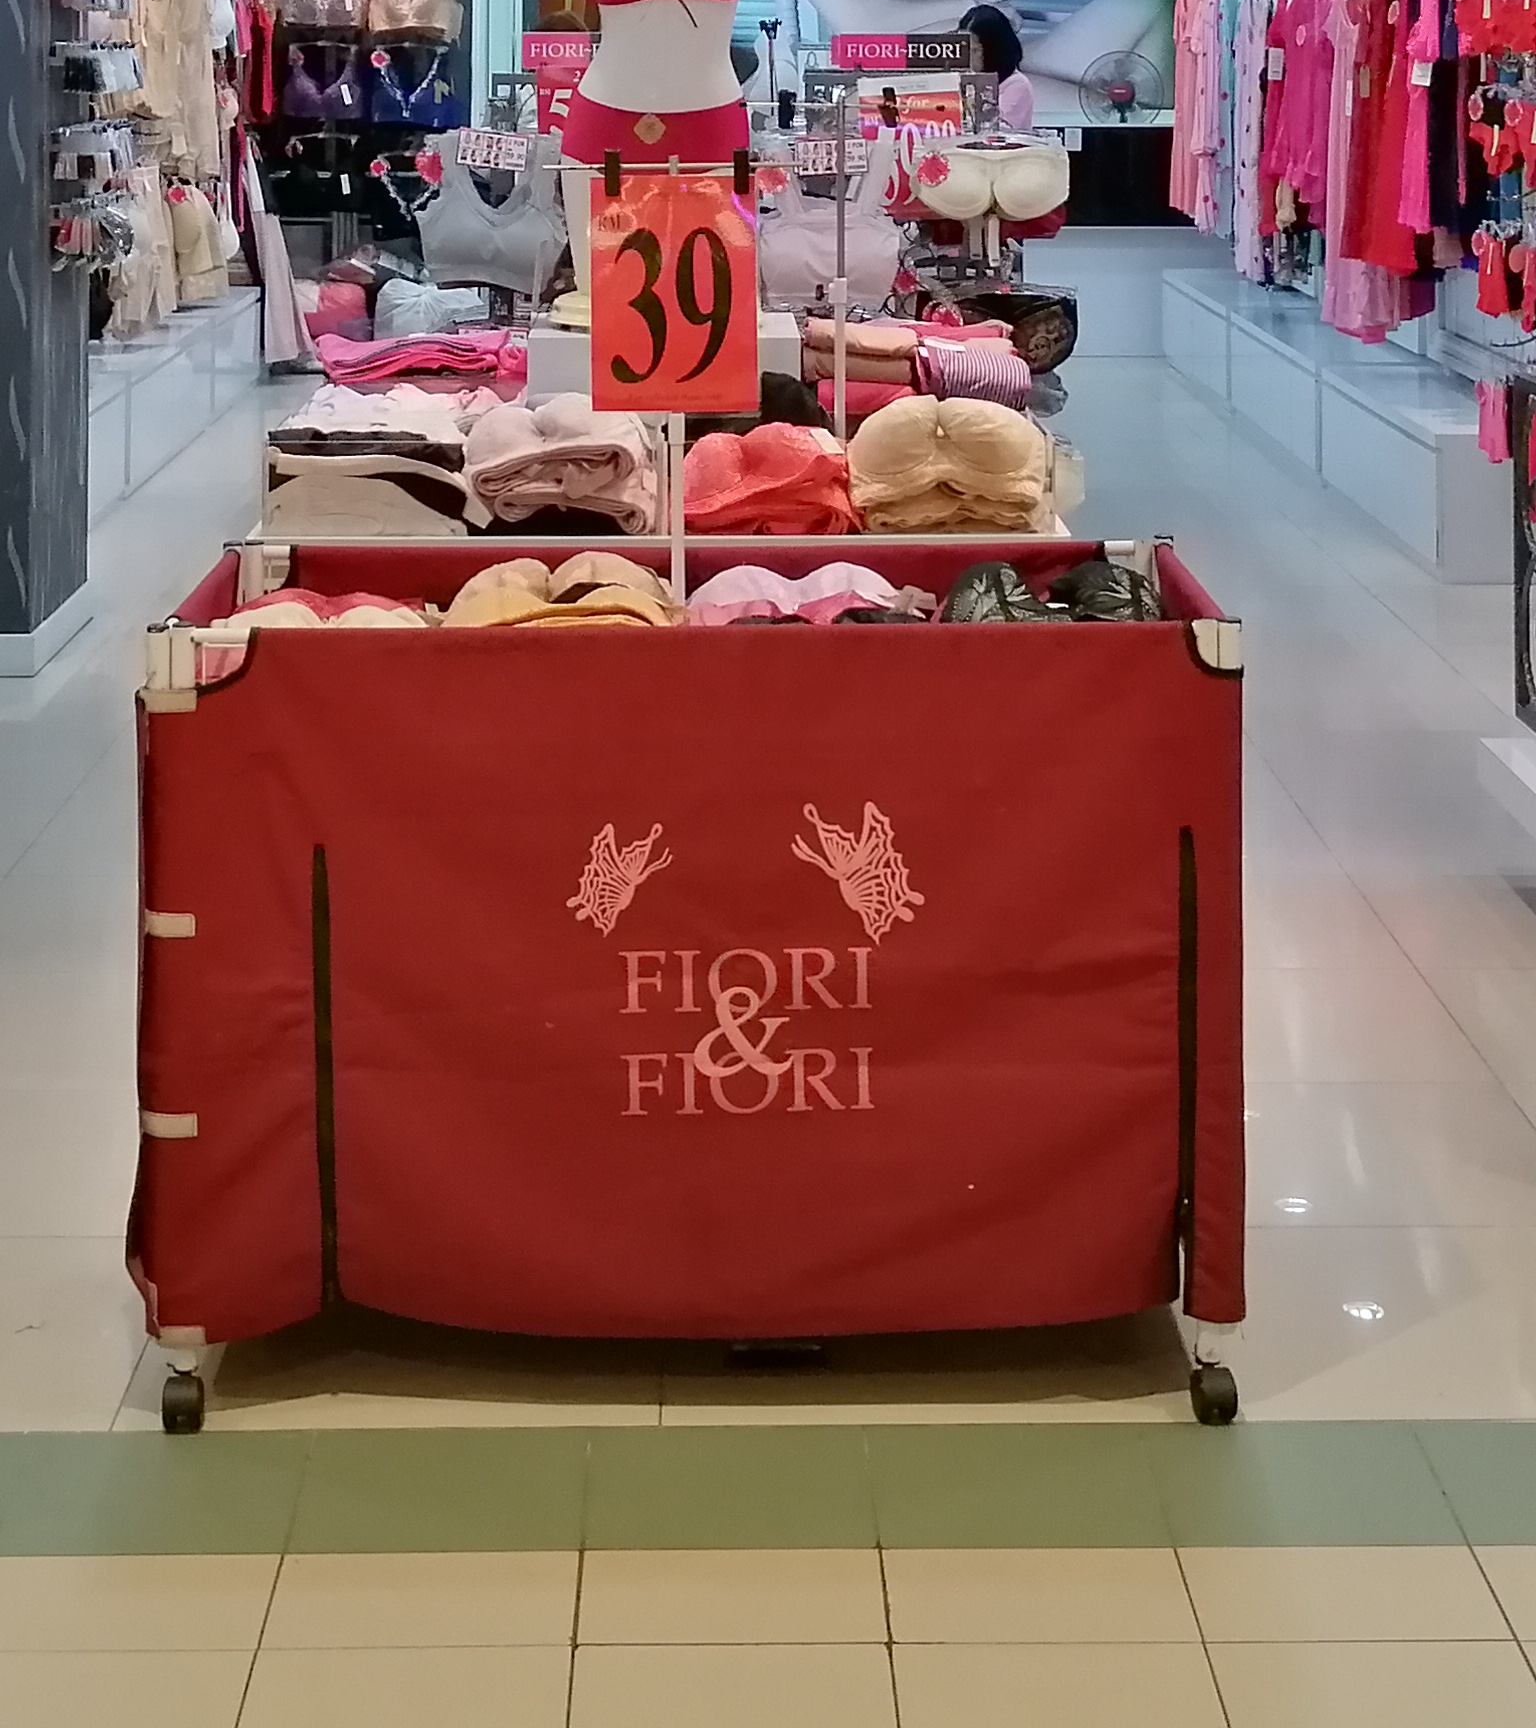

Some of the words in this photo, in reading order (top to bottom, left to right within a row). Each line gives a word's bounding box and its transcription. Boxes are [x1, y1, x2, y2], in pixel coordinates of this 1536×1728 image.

[610, 226, 733, 384] 39
[618, 946, 873, 1014] FIORI
[619, 1047, 876, 1116] FIORI
